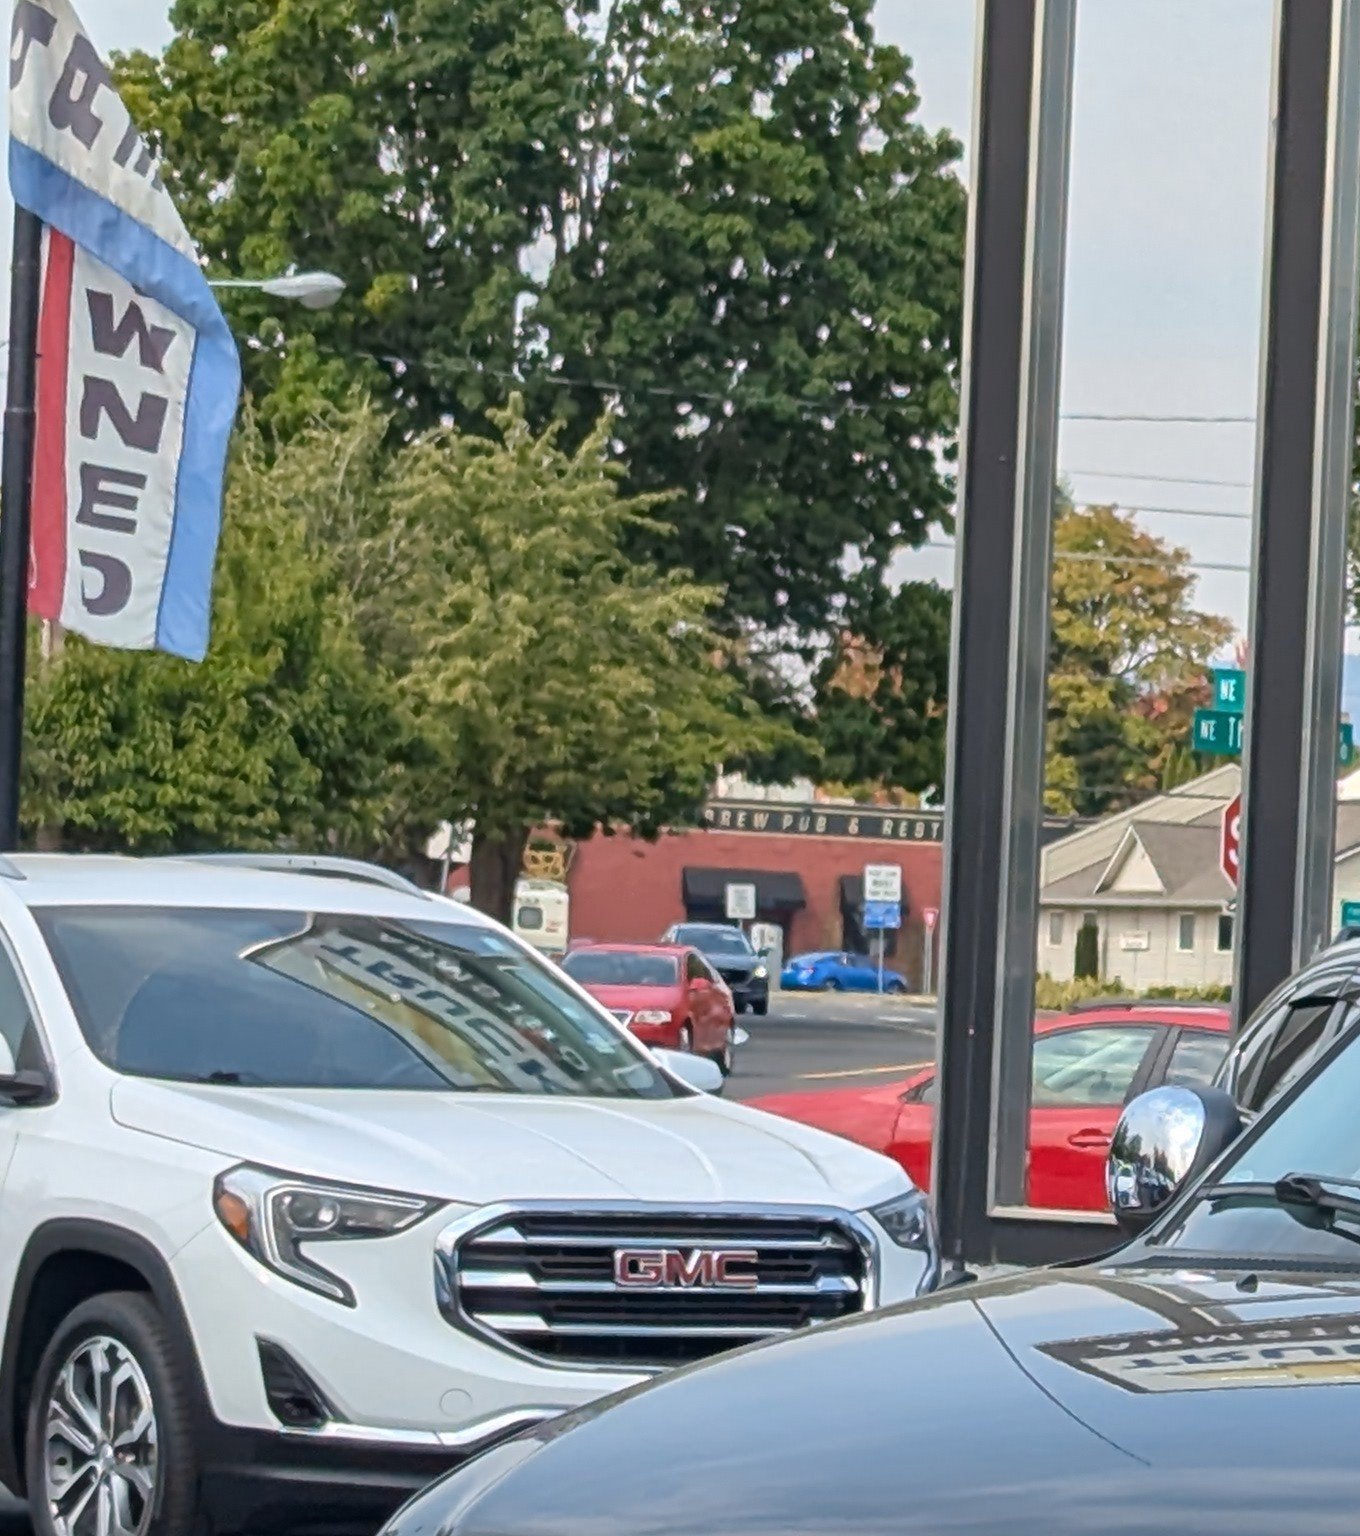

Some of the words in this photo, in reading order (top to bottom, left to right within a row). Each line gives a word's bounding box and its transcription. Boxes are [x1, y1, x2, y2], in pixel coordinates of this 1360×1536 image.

[76, 284, 177, 616] WNED
[1220, 679, 1236, 701] NE
[1201, 720, 1216, 741] NE
[782, 814, 827, 833] PUB
[614, 1250, 759, 1288] GMC
